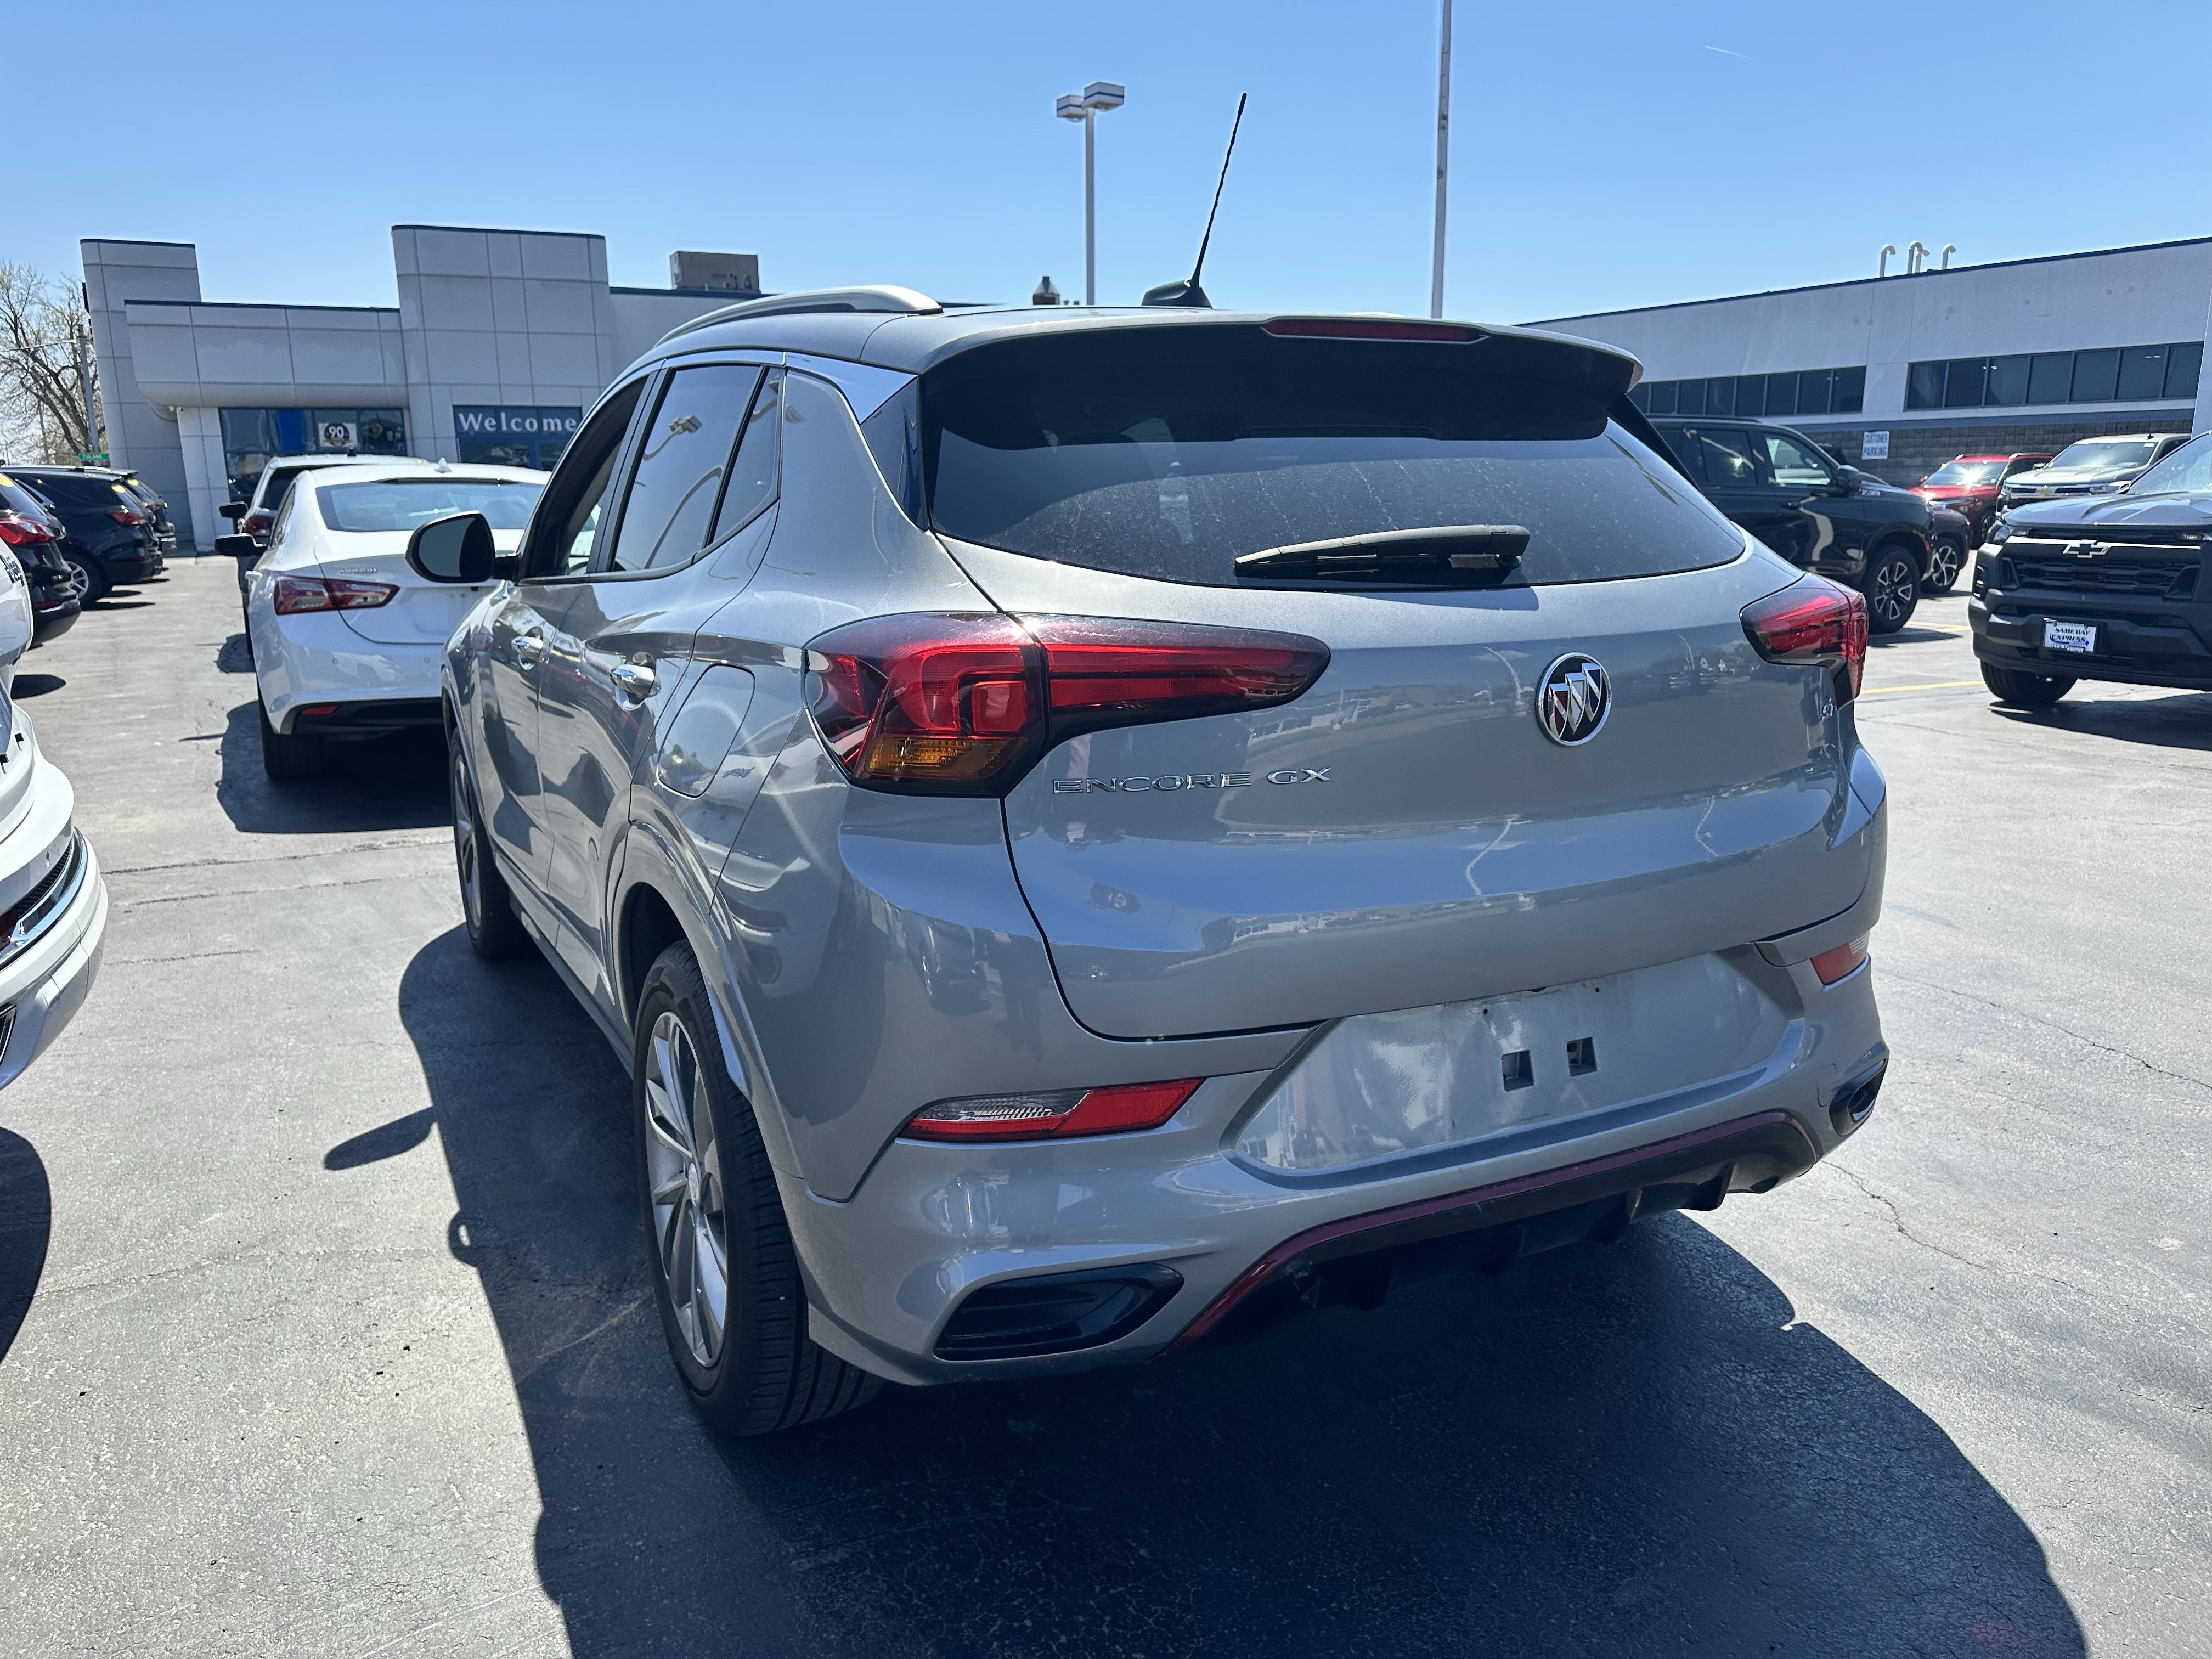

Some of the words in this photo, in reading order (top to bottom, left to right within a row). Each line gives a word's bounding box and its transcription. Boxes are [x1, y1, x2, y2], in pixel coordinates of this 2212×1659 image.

[458, 411, 577, 432] Welcome
[329, 425, 345, 438] 90
[1863, 446, 1887, 457] PARKING
[1052, 771, 1252, 794] ENCORE
[1266, 766, 1332, 785] GX
